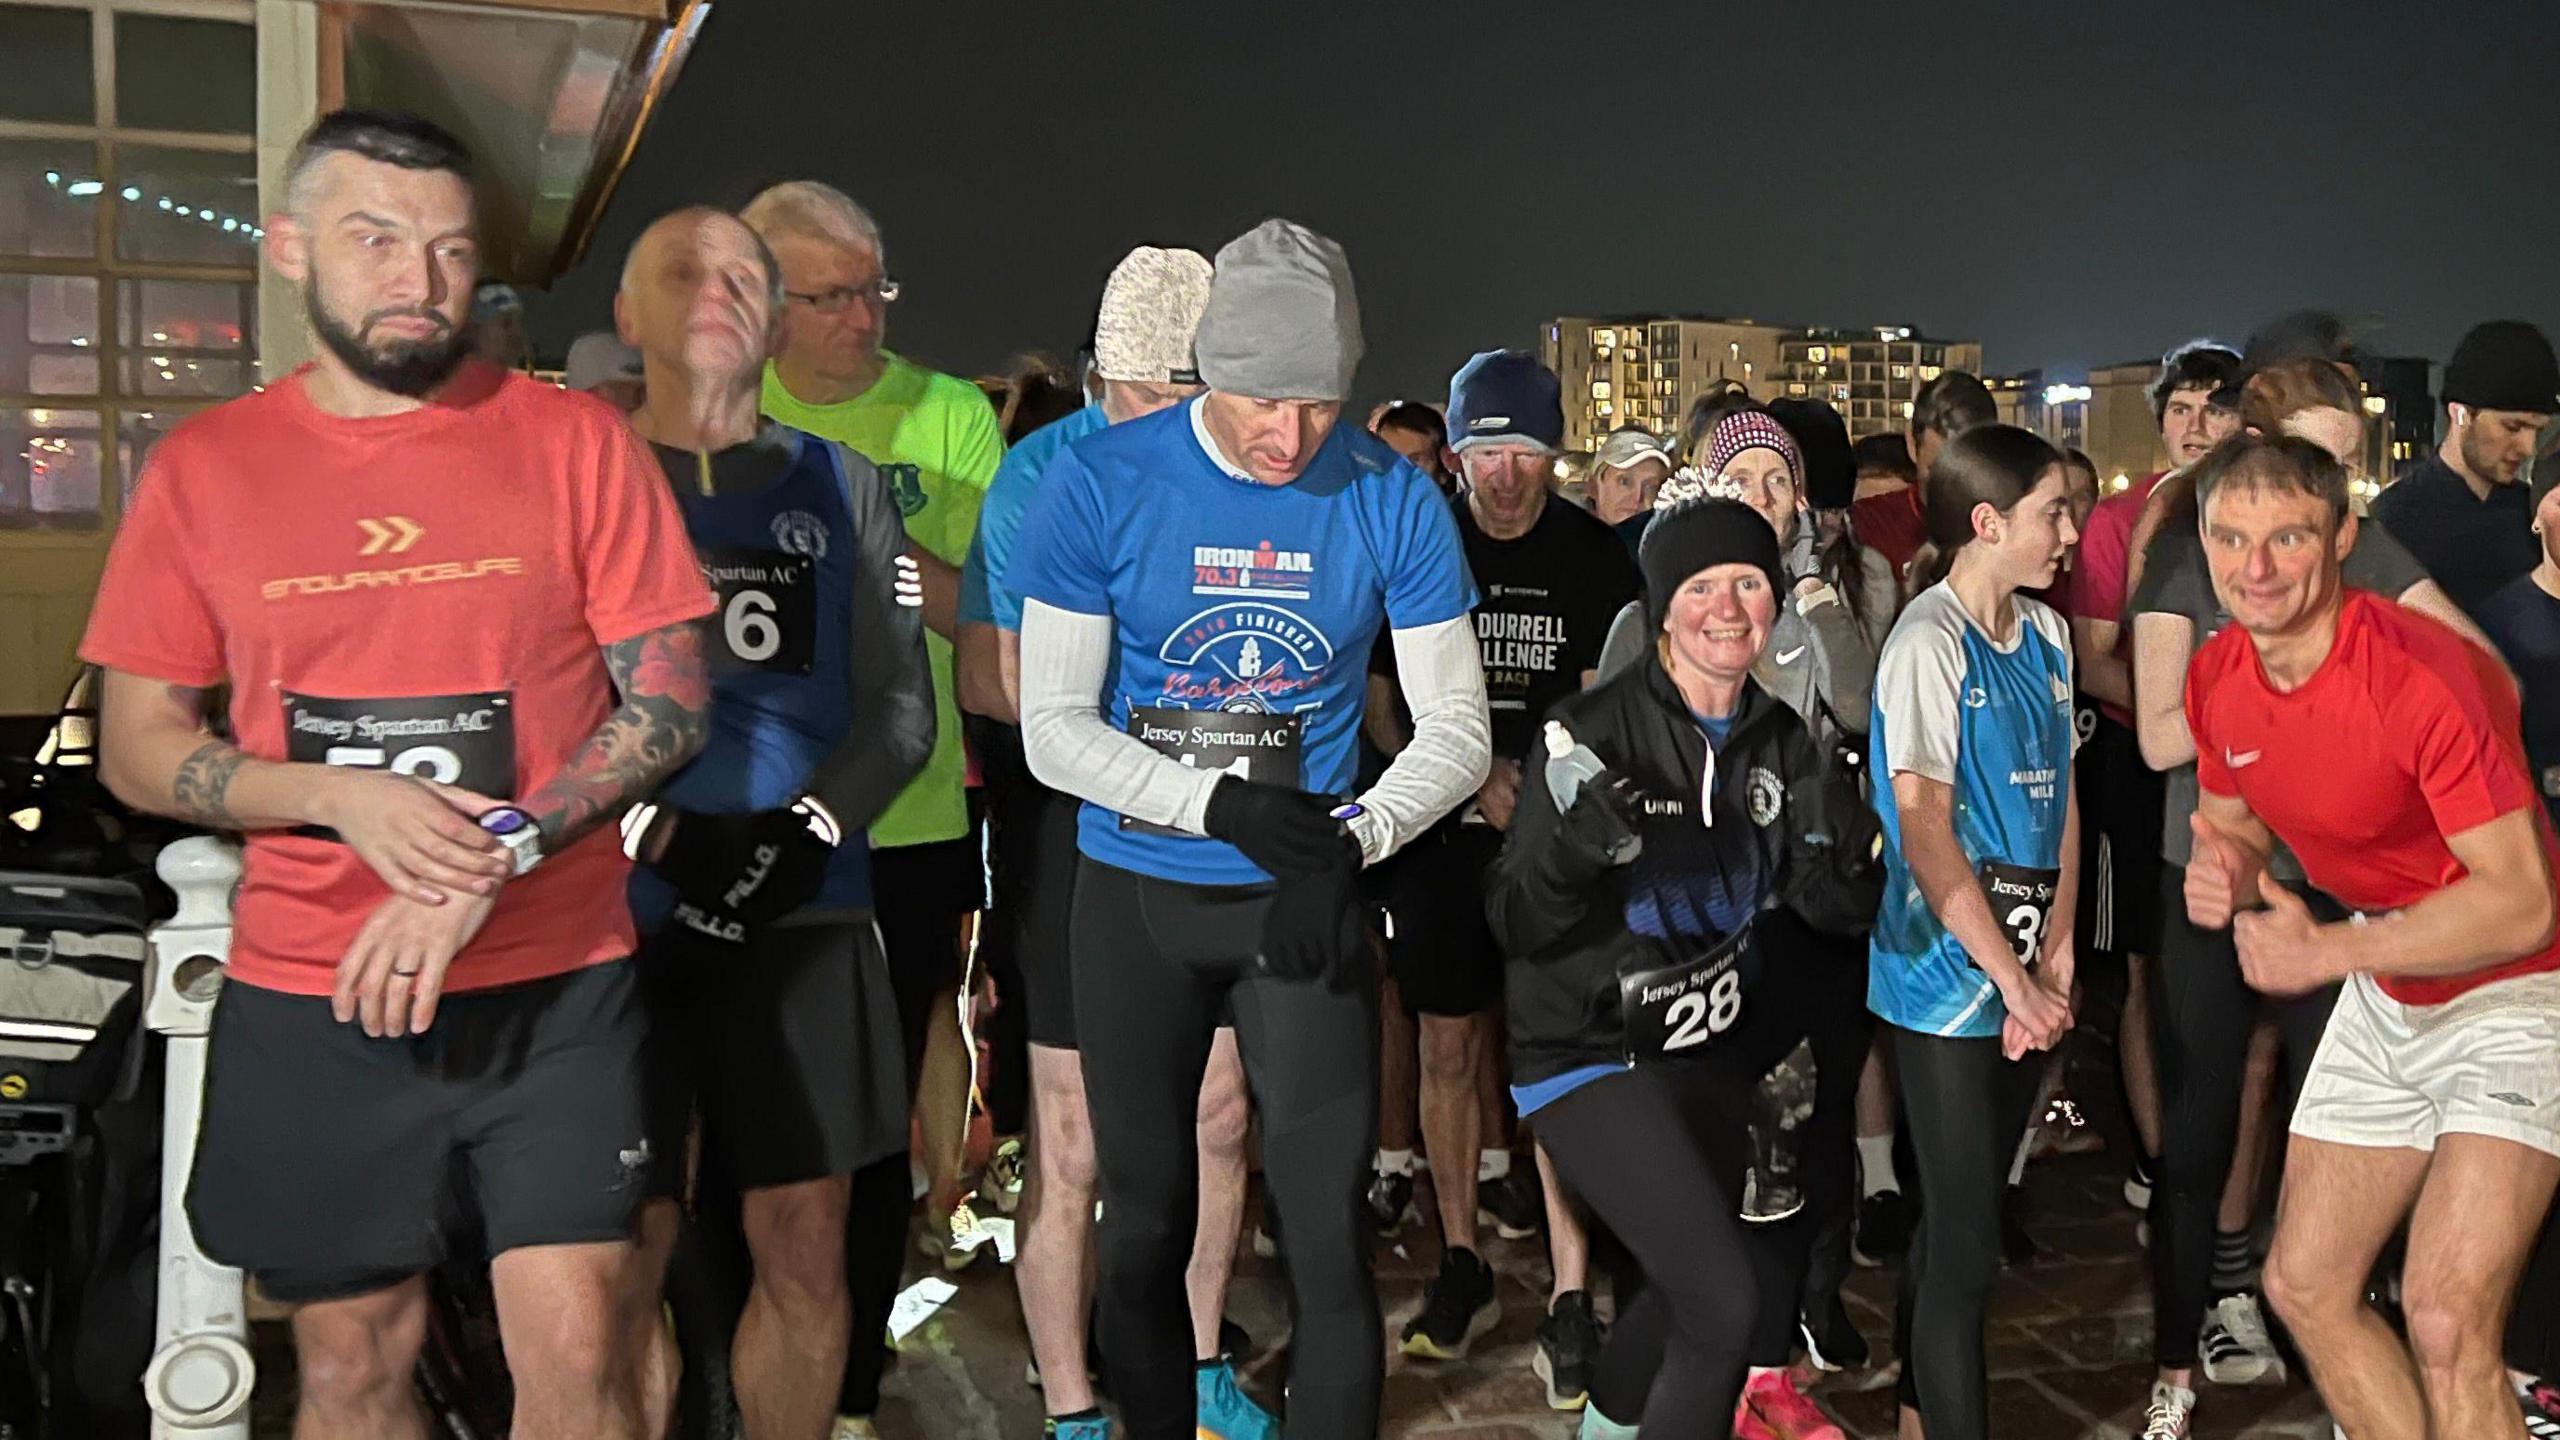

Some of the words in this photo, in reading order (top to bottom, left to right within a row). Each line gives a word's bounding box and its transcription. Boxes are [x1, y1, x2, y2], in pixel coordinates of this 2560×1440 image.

[1194, 540, 1314, 572] IRONMAN
[770, 565, 799, 586] AC
[1195, 565, 1238, 586] 70.3
[711, 590, 780, 661] 6
[1235, 612, 1315, 653] FINISHER
[1478, 612, 1567, 643] DURRELL
[354, 714, 450, 742] Spartan
[452, 708, 494, 733] AC
[1140, 722, 1188, 747] Jersey
[1191, 726, 1256, 749] Spartan
[1258, 729, 1288, 747] AC
[2029, 784, 2055, 799] MILE
[1991, 876, 2034, 901] Jersey
[1641, 978, 1687, 1006] Jersey
[1690, 952, 1735, 989] Spartan
[1662, 969, 1742, 1052] 28
